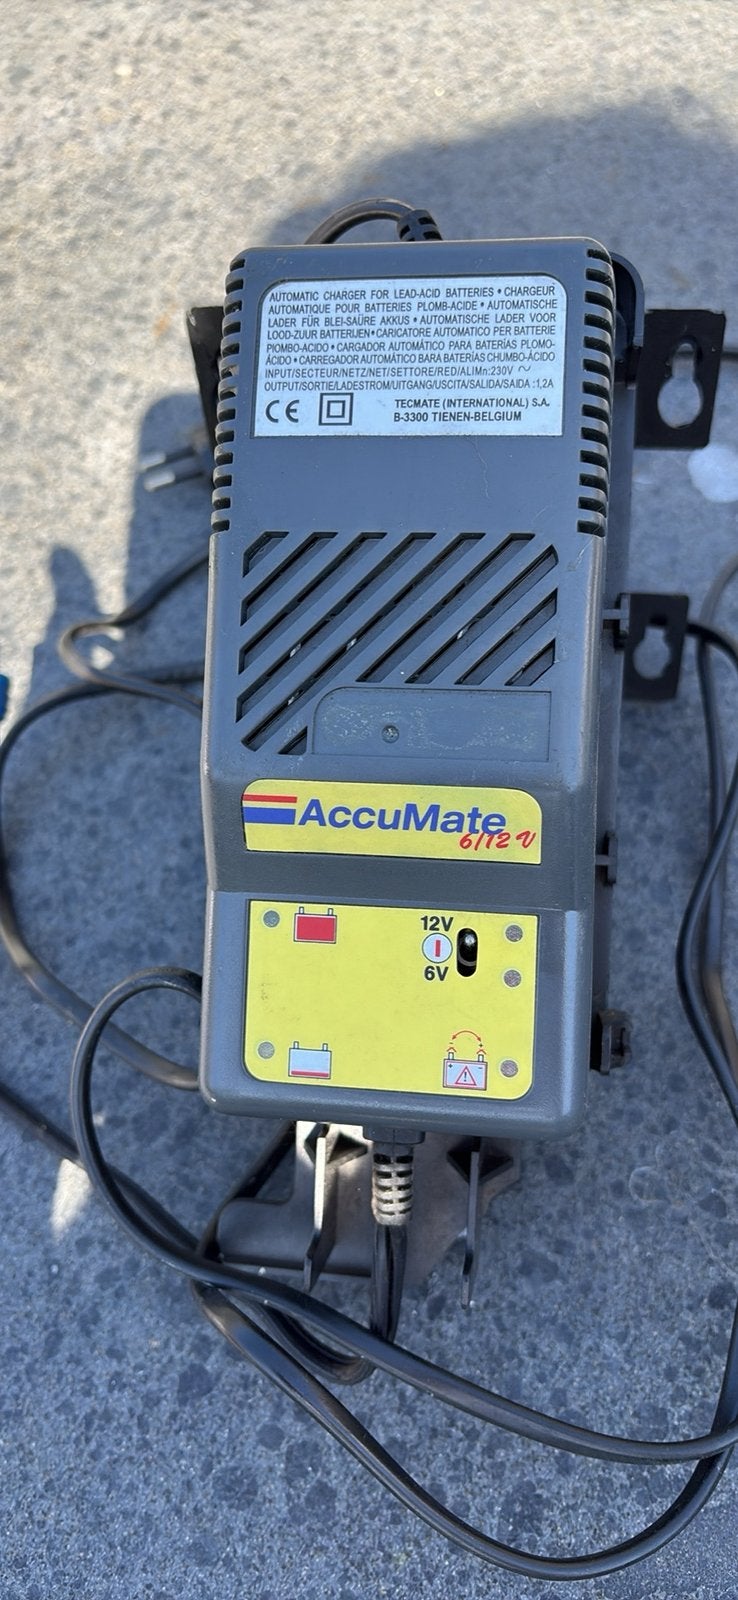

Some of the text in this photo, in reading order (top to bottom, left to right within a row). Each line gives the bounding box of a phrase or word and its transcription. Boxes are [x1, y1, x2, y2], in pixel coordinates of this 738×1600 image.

[269, 286, 555, 302] AUTOMATIC CHARGER FOR LEAD-ACID BATTERIES CHARGEUR
[268, 299, 557, 314] AUTOMATIQUE POUR BATTERIES PLOMB-ACIDE AUTOMATISCHE
[268, 313, 556, 328] LADER FÜR BLEI-SAÜRE AKKUS AUTOMATISCHE LADER VOOR
[268, 325, 556, 340] LOOD-ZUUR BATTERIJEN CARICATORE AUTOMATICO PER BATTERIE
[267, 343, 328, 353] PIOMBO-ACIDO
[336, 342, 385, 352] CARGADOR
[388, 339, 445, 351] AUTOMÁTICO
[449, 340, 472, 350] PARA
[266, 354, 292, 365] ÁCIDO
[299, 355, 359, 365] CARREGADOR
[360, 351, 416, 364] AUTOMÁTICO
[419, 353, 442, 363] BARA
[487, 350, 555, 361] CHUMBO-ÁCIDO
[395, 397, 550, 409] TECMATE (INTERNATIONAL) S.A.
[265, 400, 300, 423] CE
[393, 411, 522, 422] B-3300 TIENEN-BELGIUM
[298, 799, 506, 835] AccuMate
[420, 916, 454, 931] 12V
[424, 966, 449, 981] 6V
